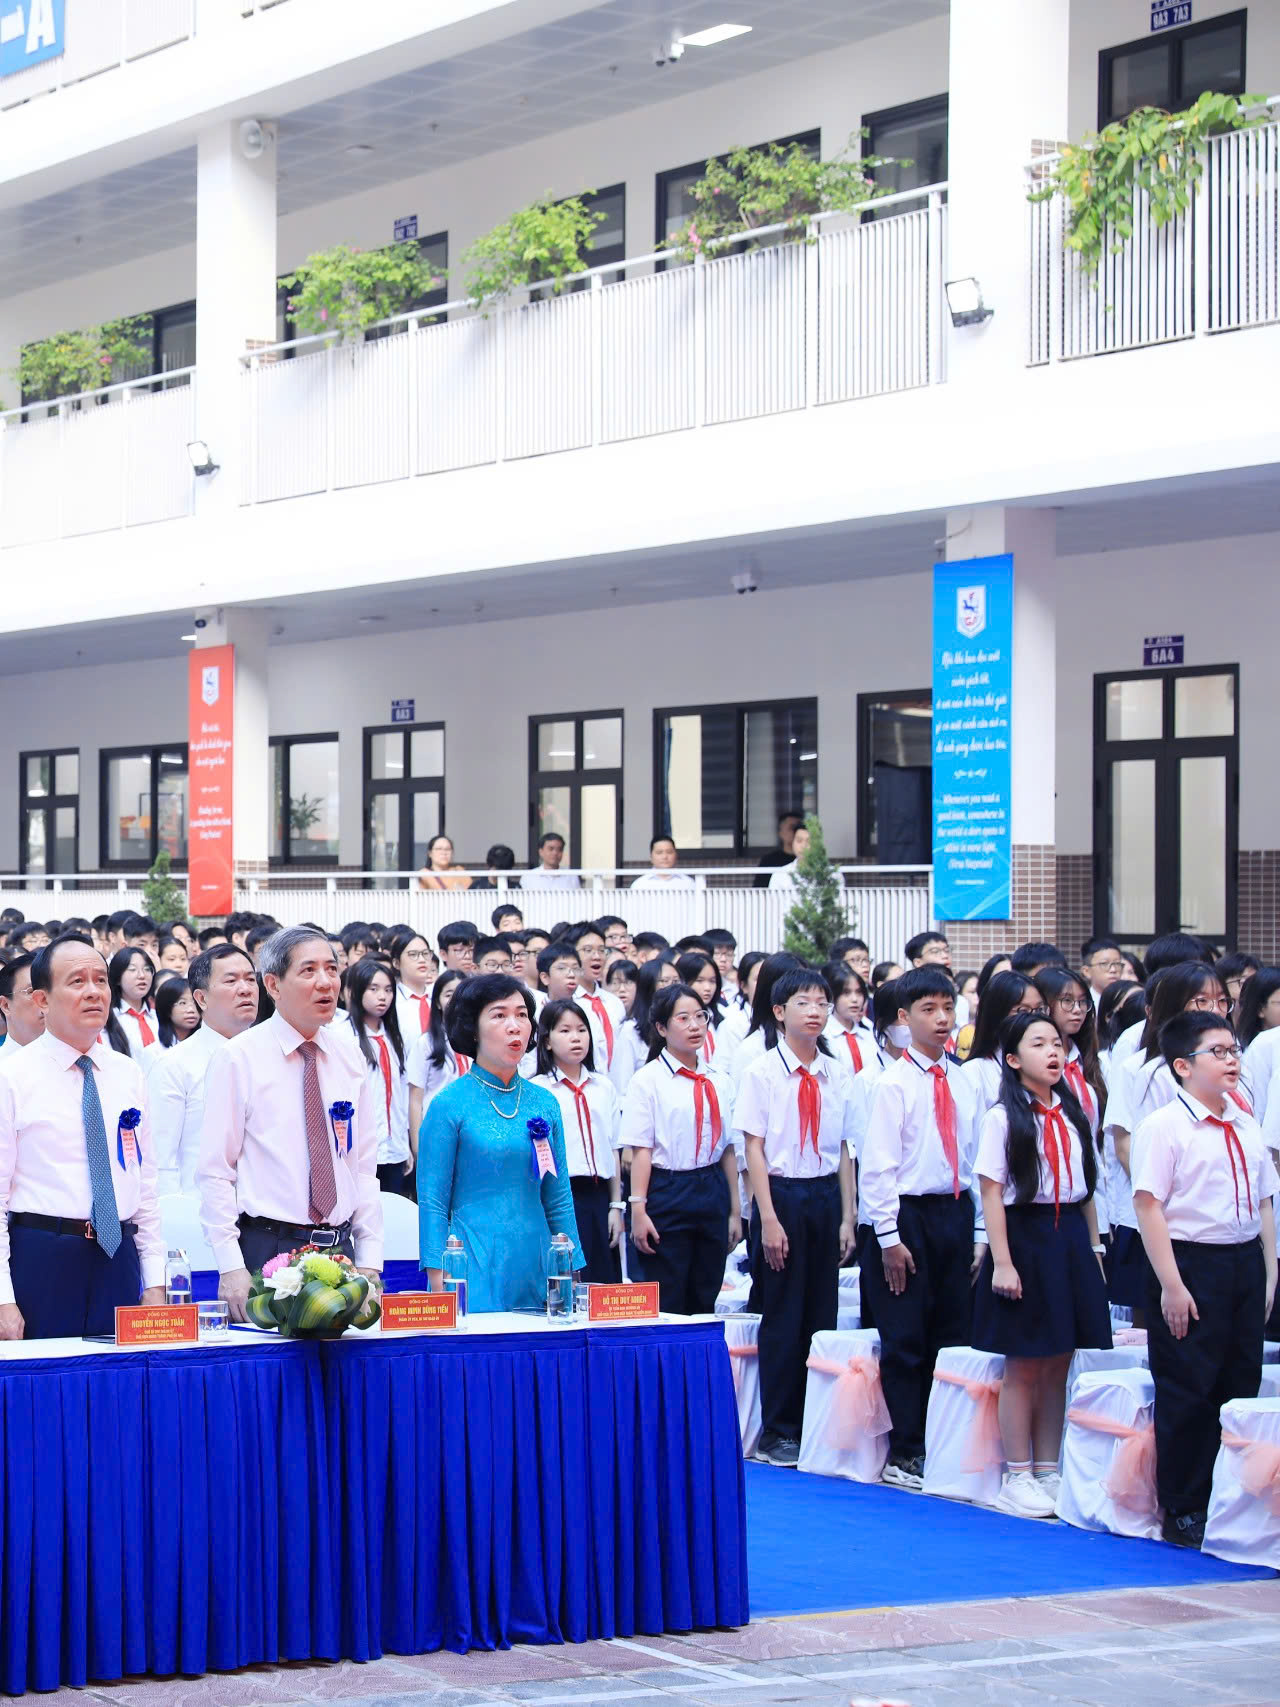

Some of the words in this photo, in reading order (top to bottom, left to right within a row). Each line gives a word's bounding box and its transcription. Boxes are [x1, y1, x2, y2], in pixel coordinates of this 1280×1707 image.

[389, 1306, 407, 1316] HOÀNG
[437, 1304, 449, 1313] TIẾN
[132, 1317, 153, 1328] NGUYỄN
[155, 1319, 169, 1329] NGỌC
[170, 1316, 185, 1327] TUẤN
